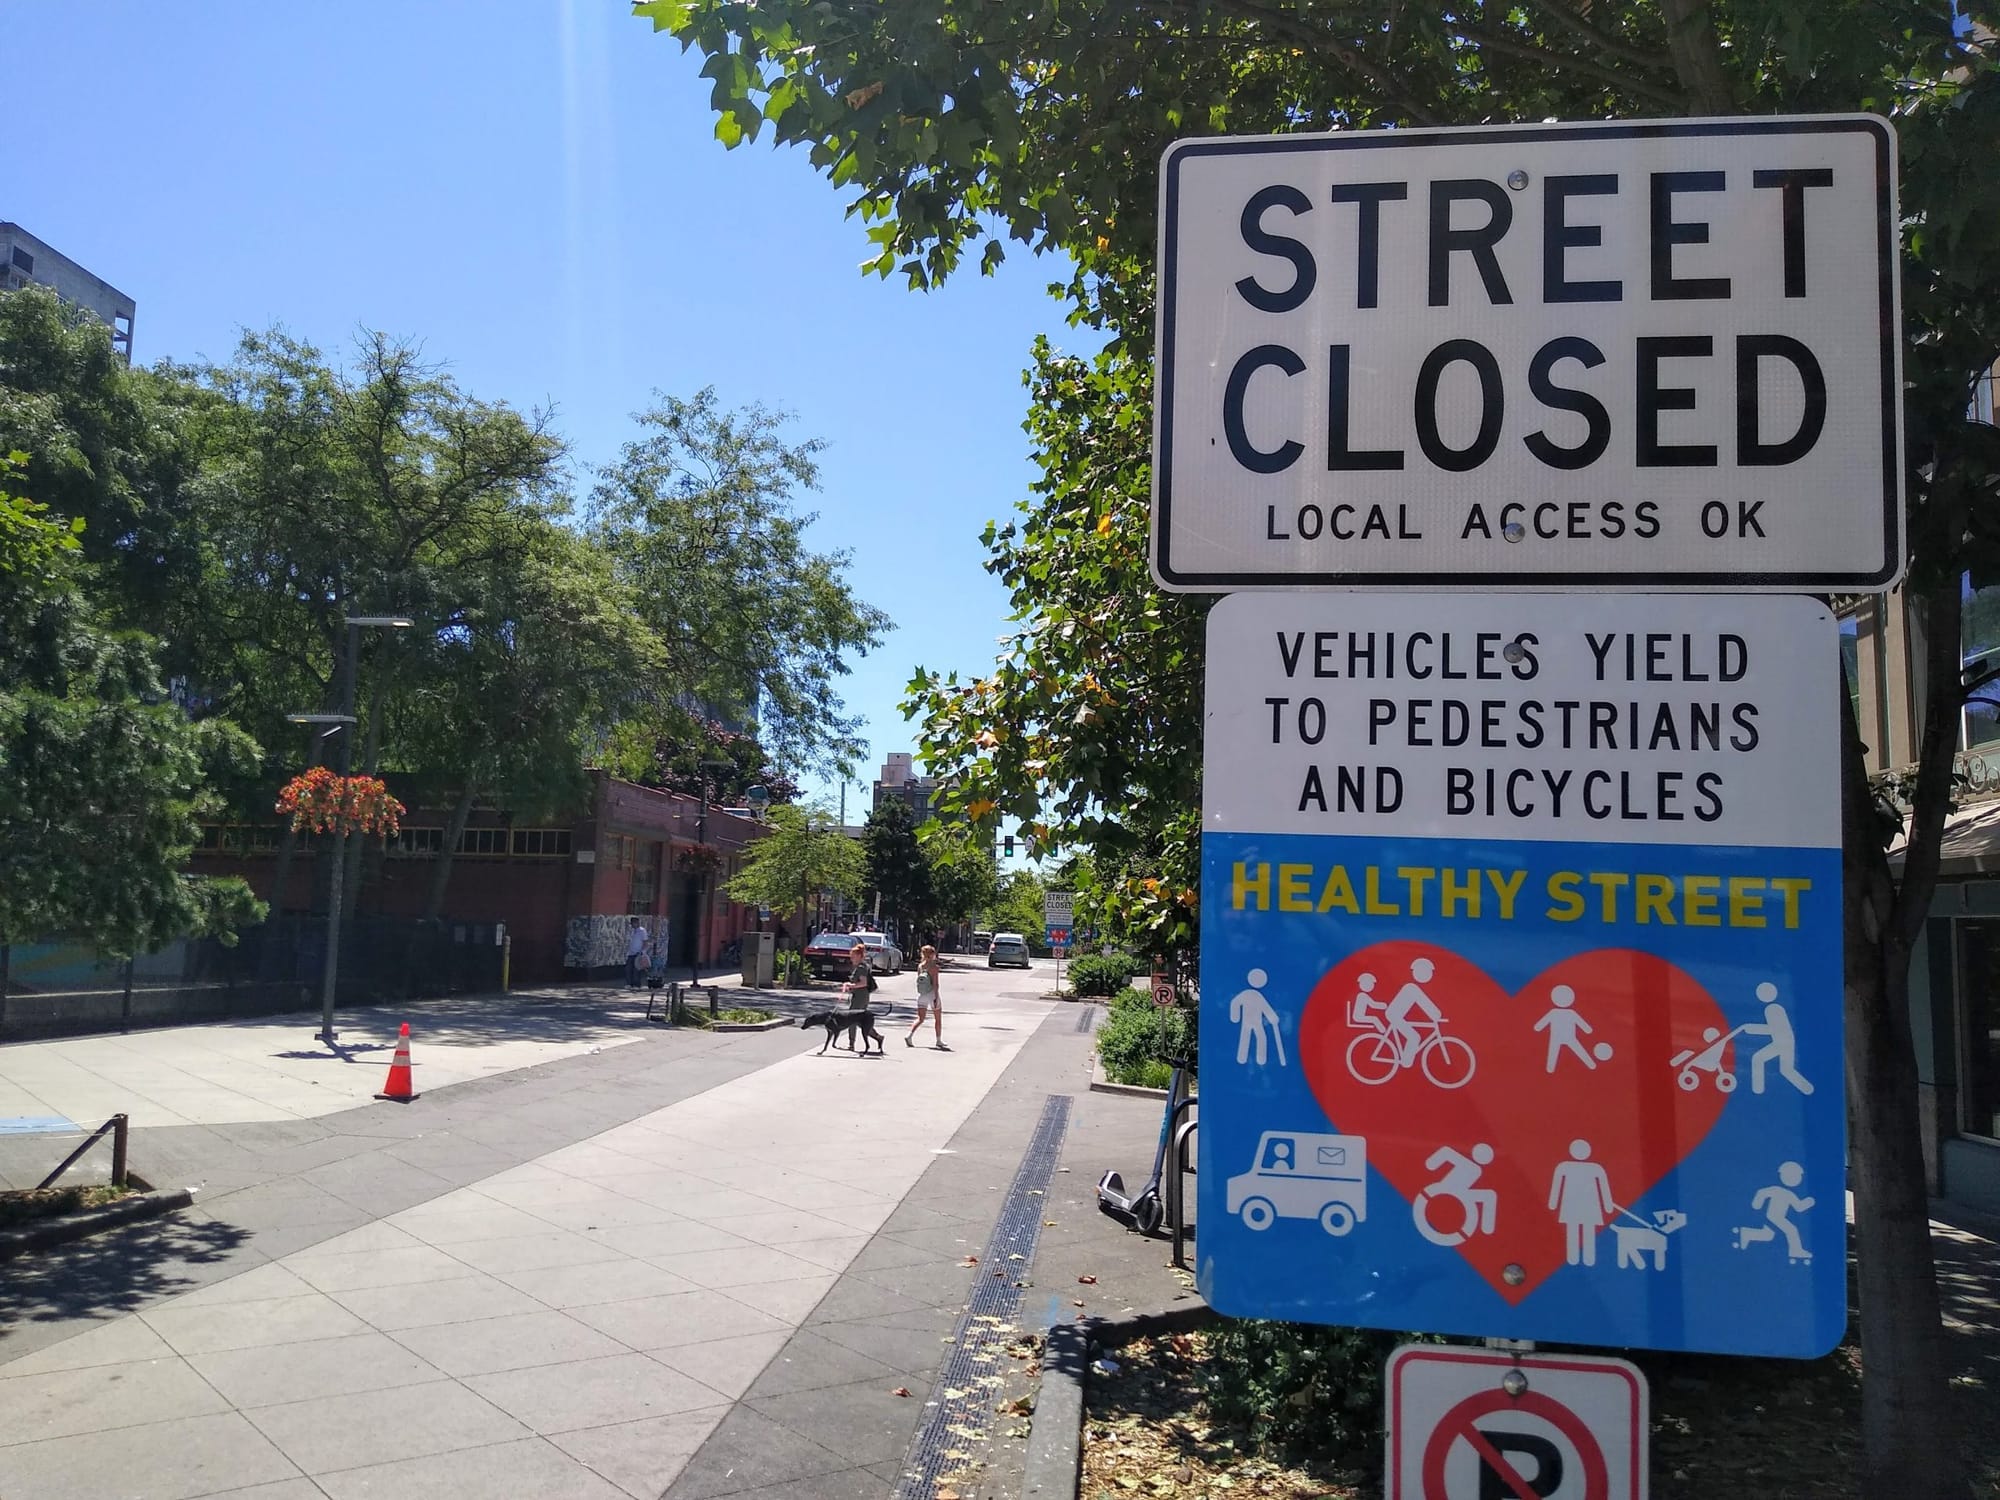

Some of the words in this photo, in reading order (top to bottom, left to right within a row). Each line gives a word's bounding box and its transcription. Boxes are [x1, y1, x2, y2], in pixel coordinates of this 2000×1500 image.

[1235, 168, 1833, 313] STREET
[1223, 334, 1828, 474] CLOSED
[1268, 504, 1423, 540] LOCAL
[1461, 501, 1660, 540] ACCESS
[1701, 500, 1767, 539] OK
[1277, 632, 1540, 681] VEHICLES
[1583, 633, 1748, 682] YIELD
[1265, 698, 1327, 746] TO
[1369, 699, 1760, 752] PEDESTRIANS
[1298, 765, 1404, 813] AND
[1447, 768, 1724, 822] BICYCLES
[1046, 901, 1073, 909] CLOSED
[1234, 863, 1526, 918] HEALTHY
[1548, 873, 1811, 928] STREET
